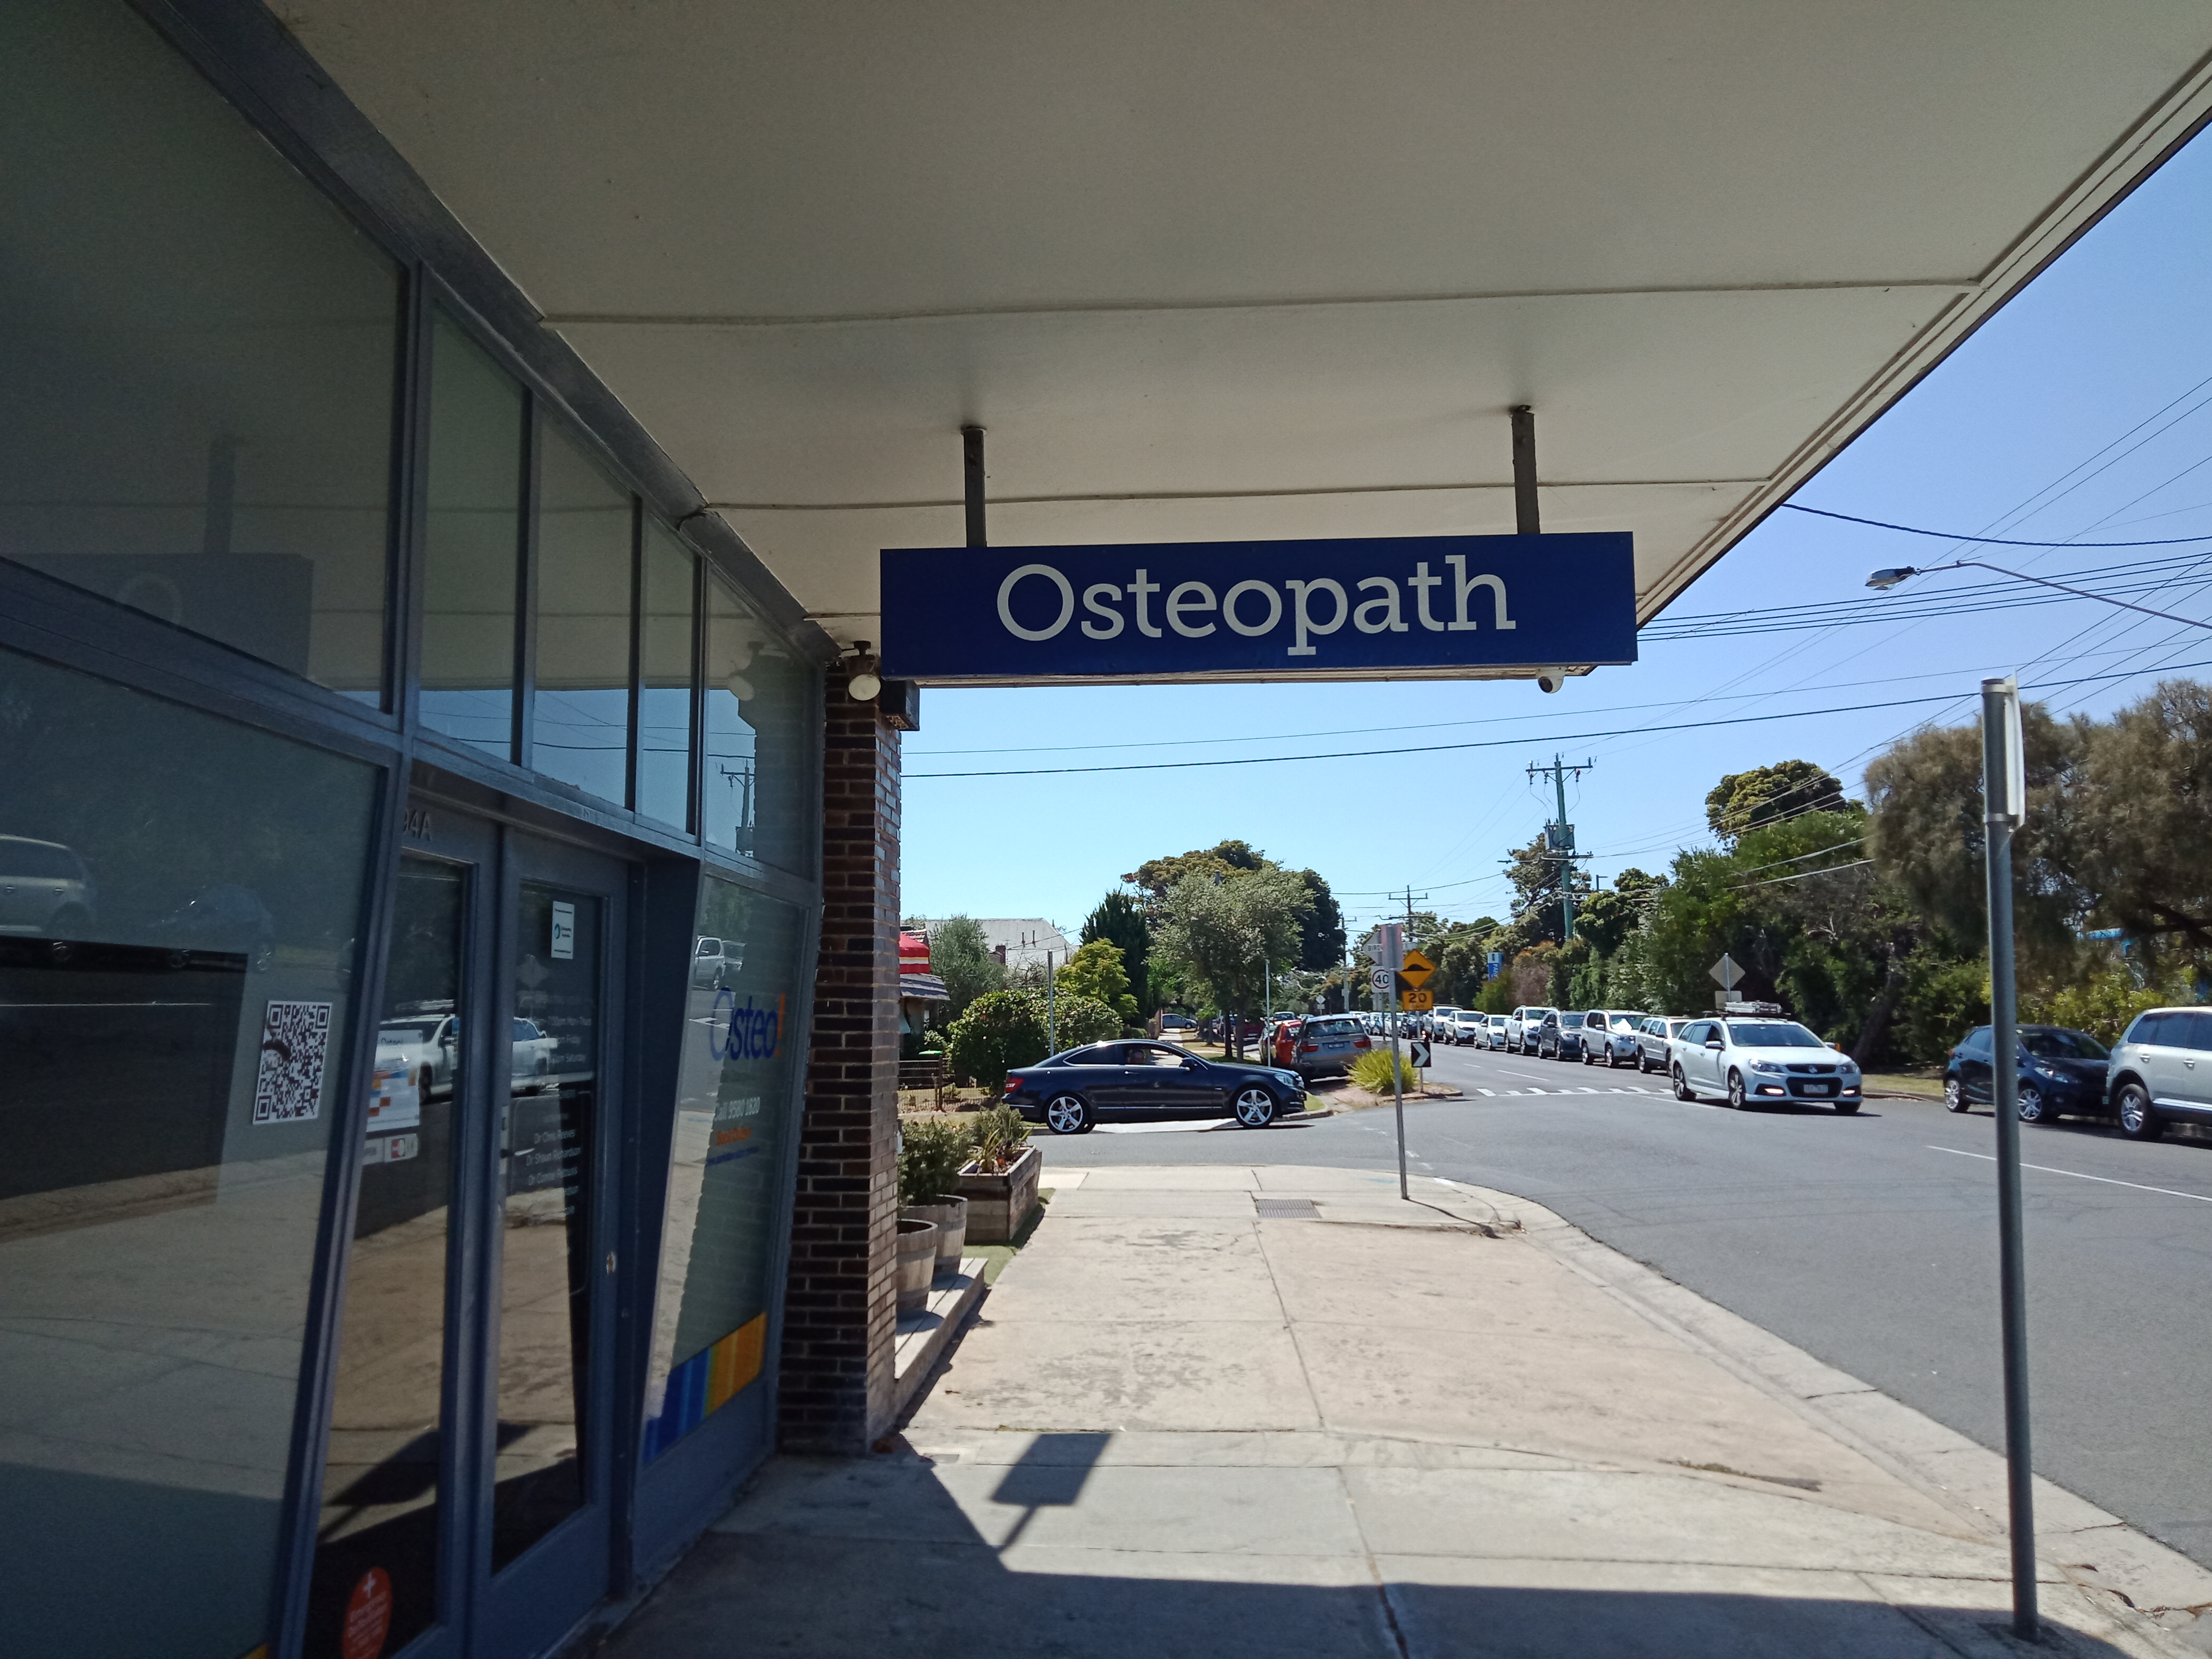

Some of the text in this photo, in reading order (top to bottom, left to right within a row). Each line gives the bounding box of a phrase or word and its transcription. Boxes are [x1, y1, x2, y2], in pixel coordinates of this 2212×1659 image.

[996, 554, 1516, 657] Osteopath
[1375, 974, 1389, 984] 40
[1408, 992, 1427, 1003] 20
[710, 987, 786, 1061] Osteo!
